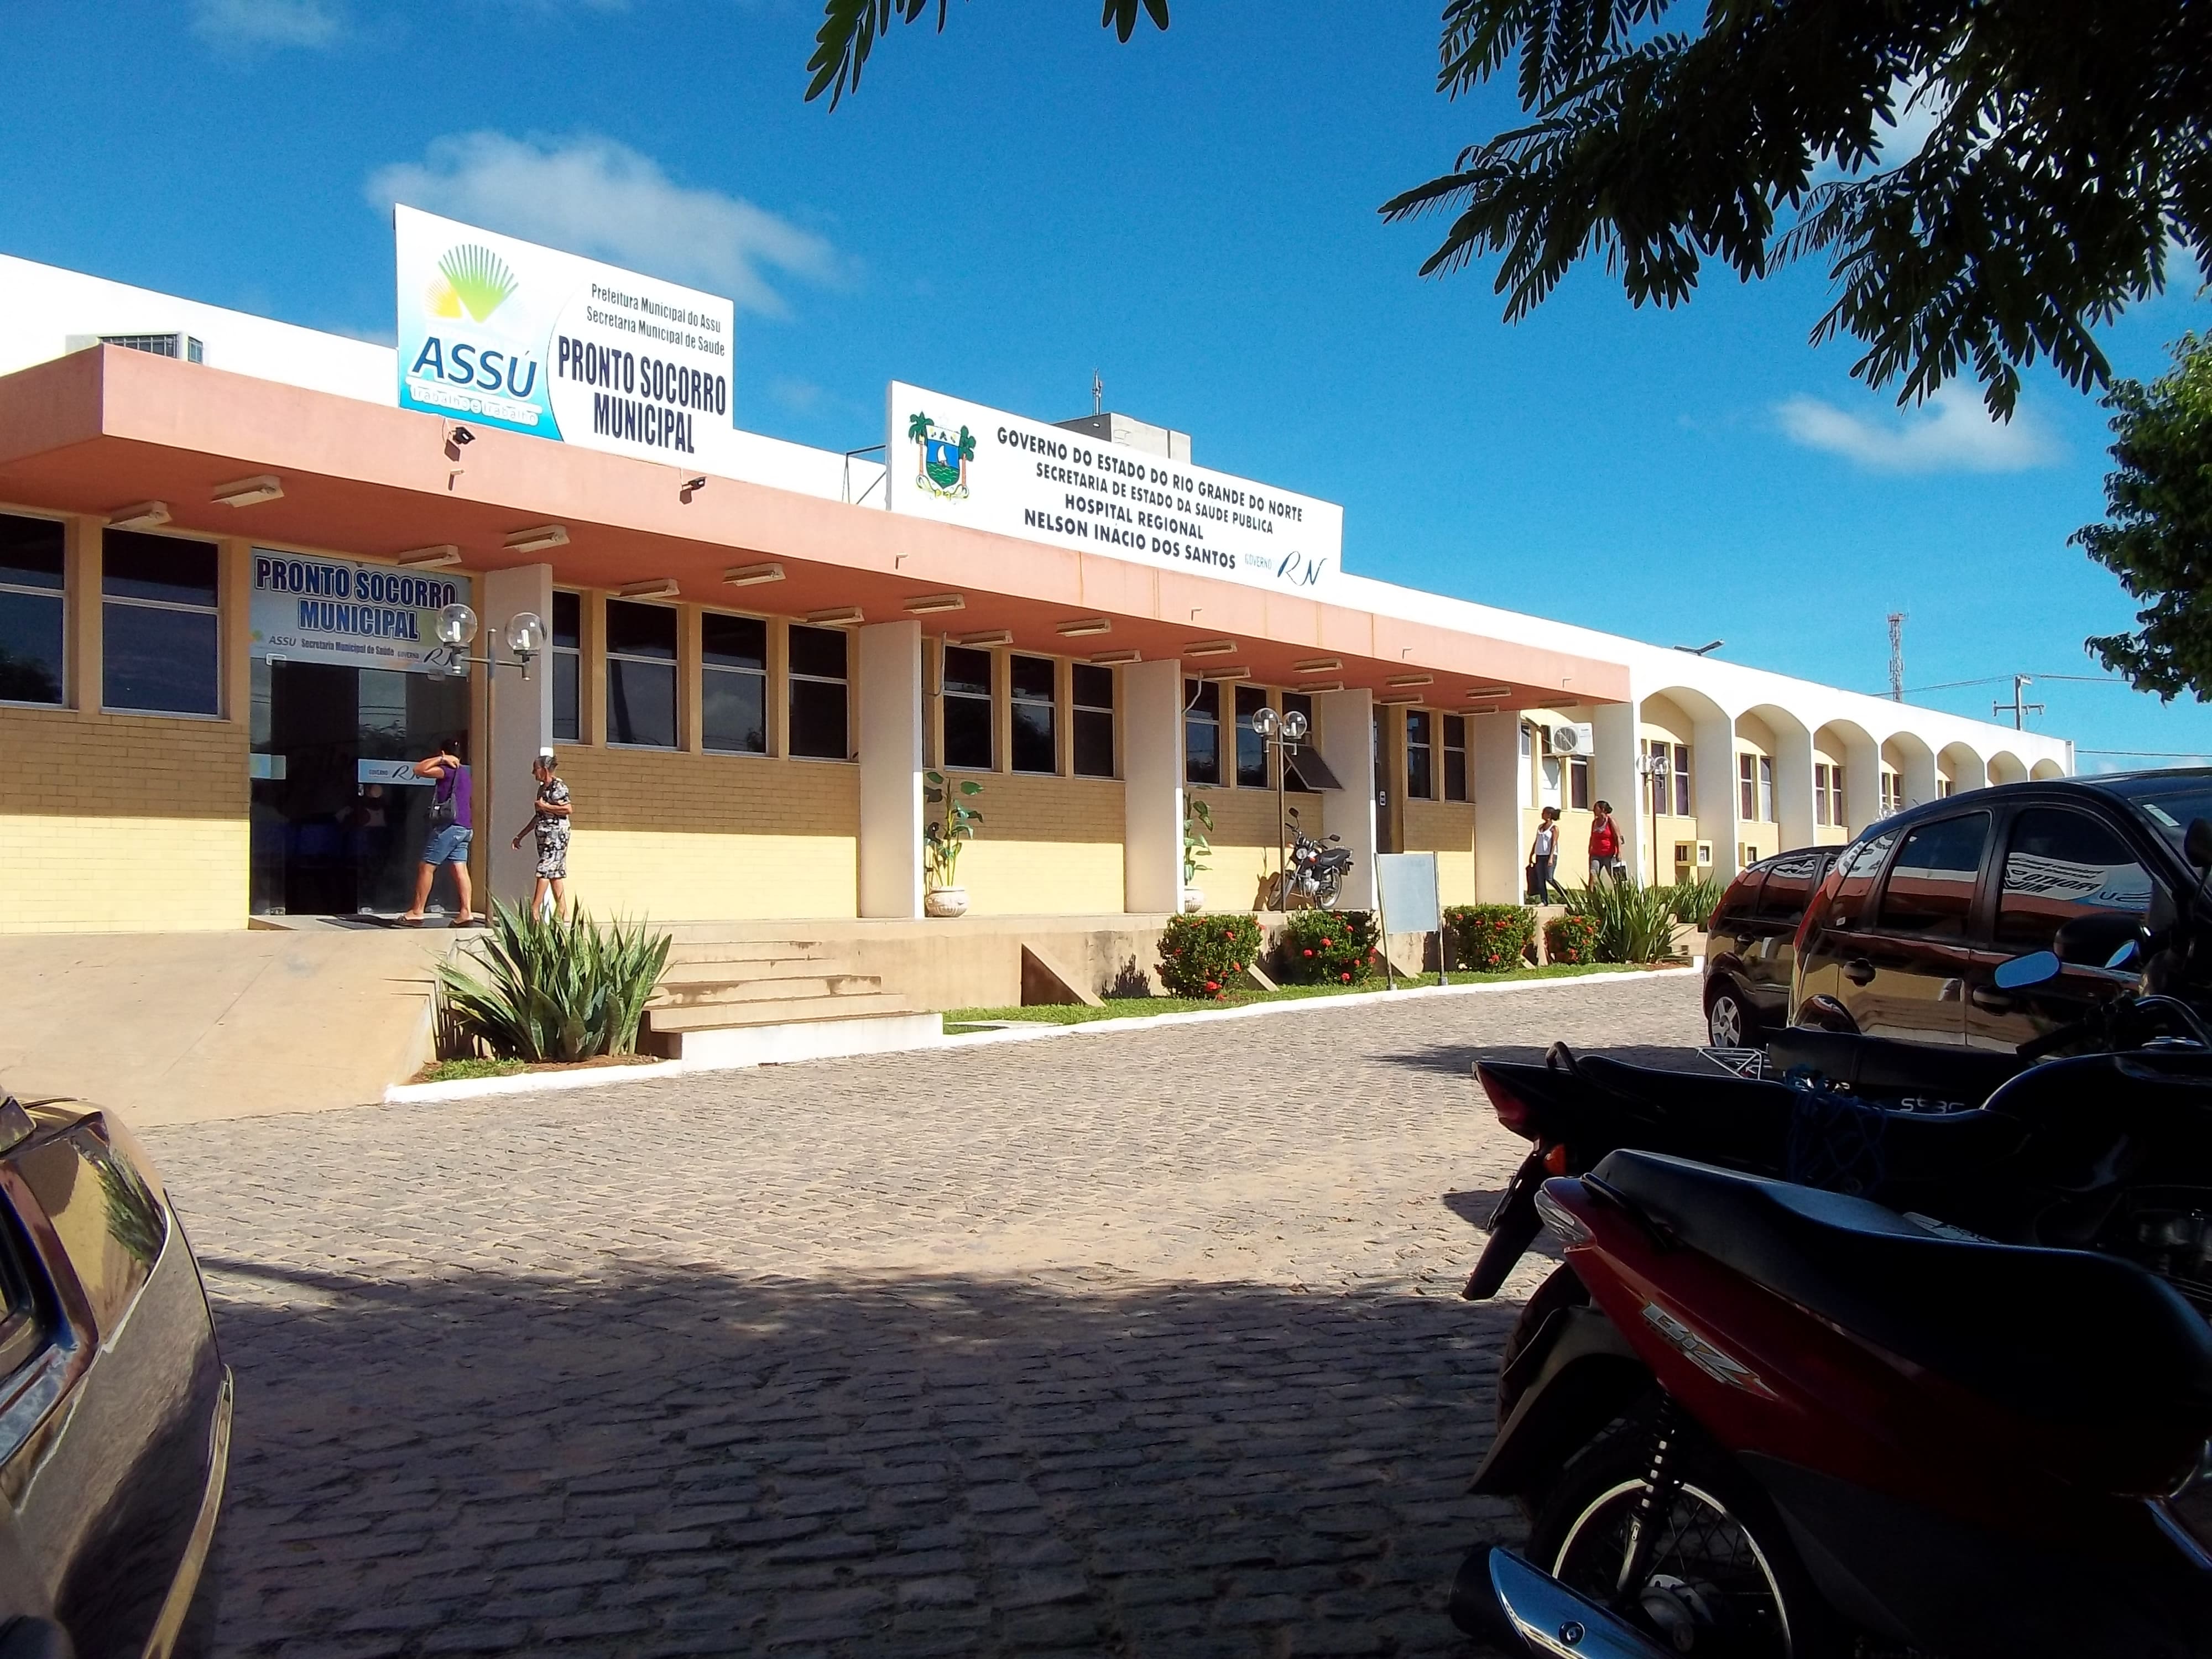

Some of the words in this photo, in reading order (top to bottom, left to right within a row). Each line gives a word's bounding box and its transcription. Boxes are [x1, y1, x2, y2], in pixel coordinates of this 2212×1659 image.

[587, 306, 636, 333] Secretaria
[638, 320, 683, 345] Municipal
[685, 333, 696, 349] de
[592, 283, 638, 310] Prefeitura
[641, 297, 685, 323] Municipal
[687, 311, 698, 327] do
[411, 336, 538, 398] ASSÚ
[559, 335, 634, 394] PRONTO
[640, 356, 726, 415] SOCORRO
[594, 392, 695, 453] MUNICIPAL
[997, 427, 1067, 461] GOVERNO
[1073, 447, 1092, 467] DO
[1098, 453, 1145, 481] ESTADO
[1151, 468, 1168, 486] DO
[1173, 474, 1193, 493] RIO
[1198, 481, 1245, 507] GRANDE
[1249, 494, 1264, 512] DO
[1269, 500, 1302, 522] NORTE
[1036, 462, 1108, 493] SECRETARIA
[1113, 481, 1126, 498] DE
[1131, 486, 1172, 509] ESTADO
[1177, 498, 1191, 514] DA
[1025, 508, 1088, 538] NELSON
[1152, 537, 1180, 557] DOS
[1185, 544, 1235, 570] SANTOS
[1066, 493, 1133, 523] HOSPITAL
[1138, 511, 1203, 540] REGIONAL
[255, 555, 352, 599] PRONTO
[355, 570, 458, 611] SOCORRO
[1244, 553, 1272, 570] GOVERNO
[299, 598, 420, 641] MUNICIPAL
[301, 638, 334, 650] Secretaria
